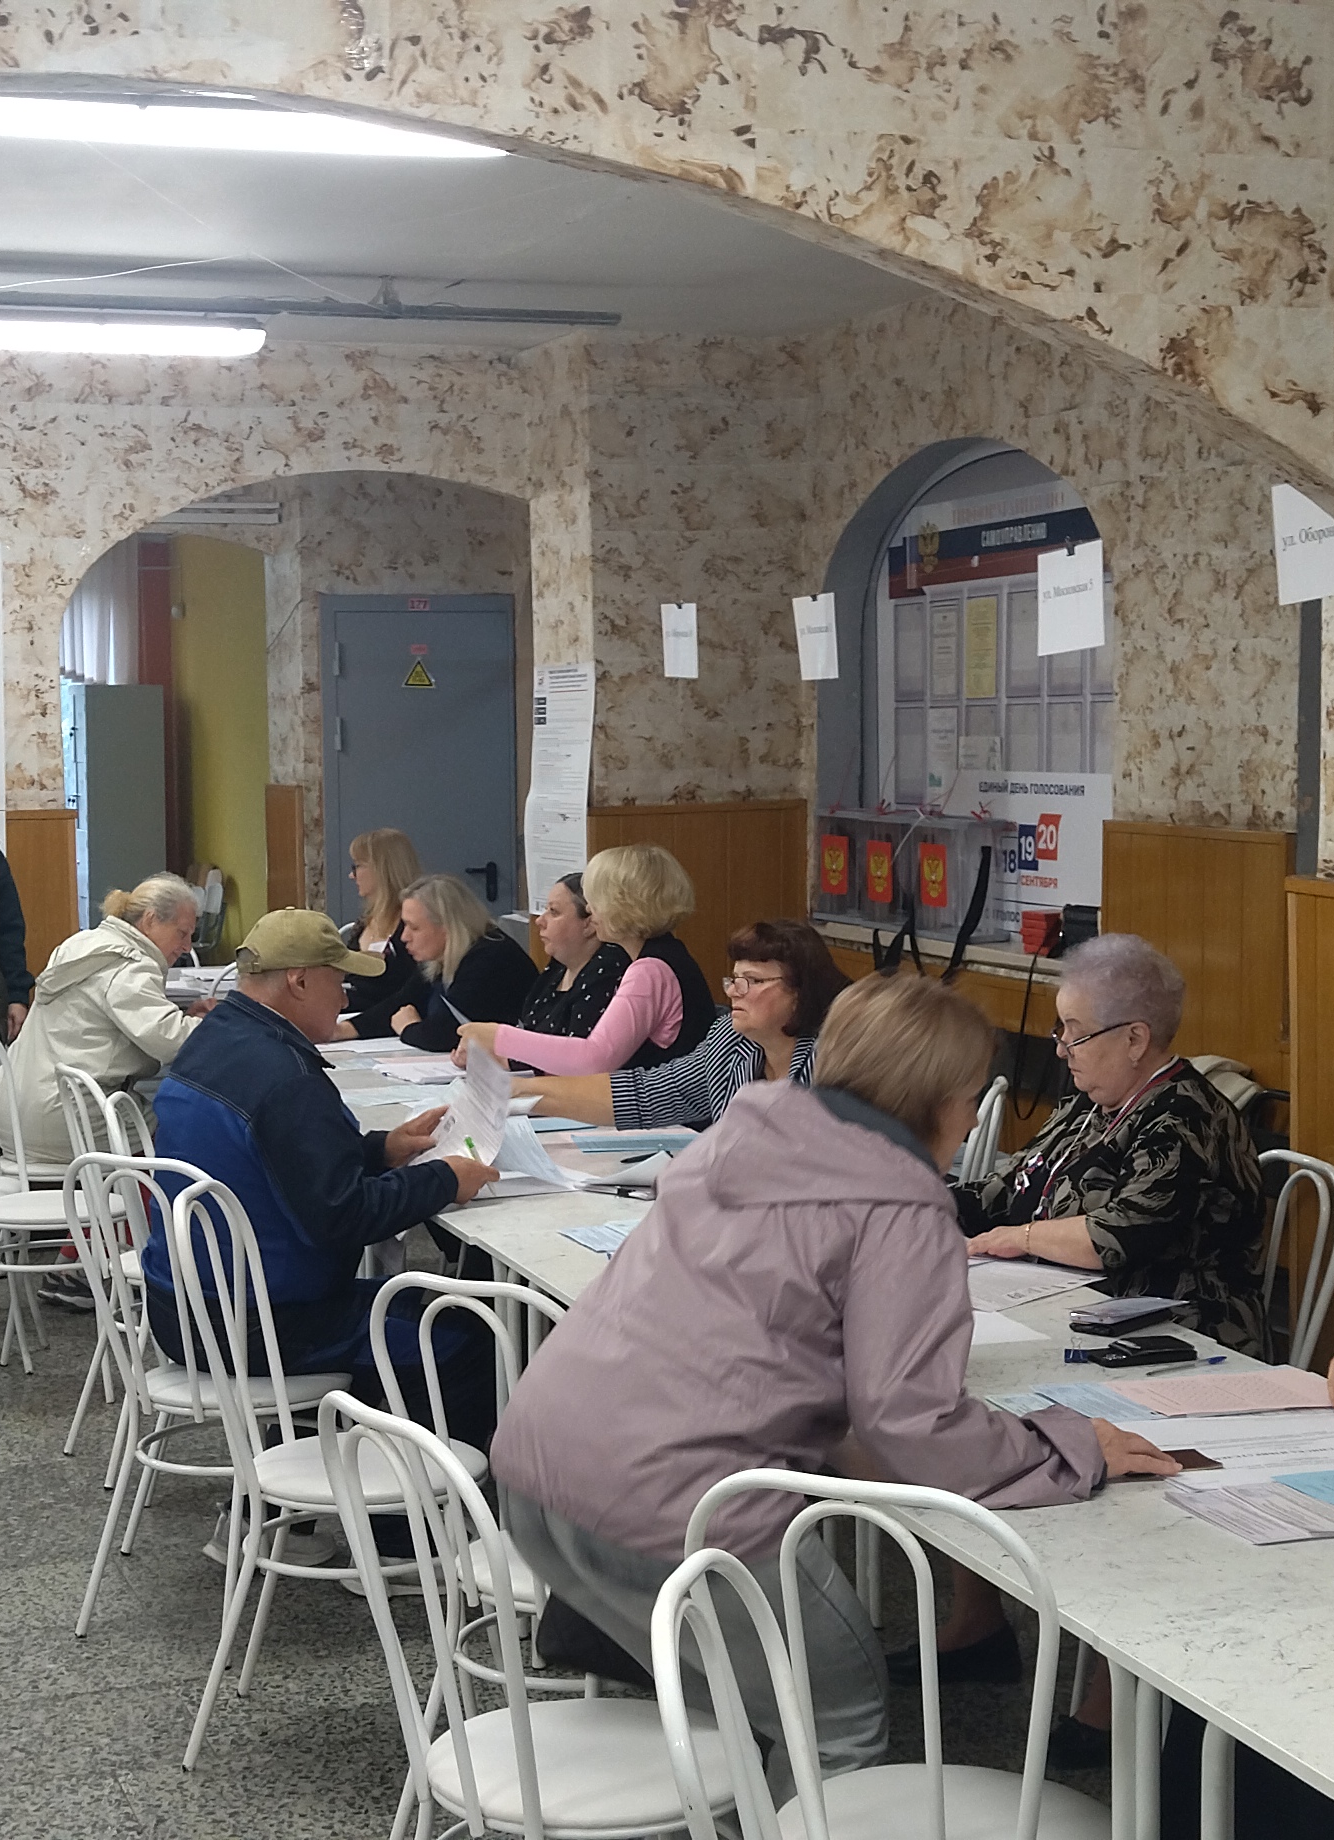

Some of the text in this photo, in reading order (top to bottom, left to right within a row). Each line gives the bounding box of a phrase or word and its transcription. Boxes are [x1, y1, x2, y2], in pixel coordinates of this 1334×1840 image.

[978, 780, 1085, 796] ЕДИНЫЙ ДЕНЬ ГОЛОСОВАНИЯ
[1002, 824, 1057, 873] 18 19 20
[1020, 875, 1058, 889] СЕНТЯБРЯ
